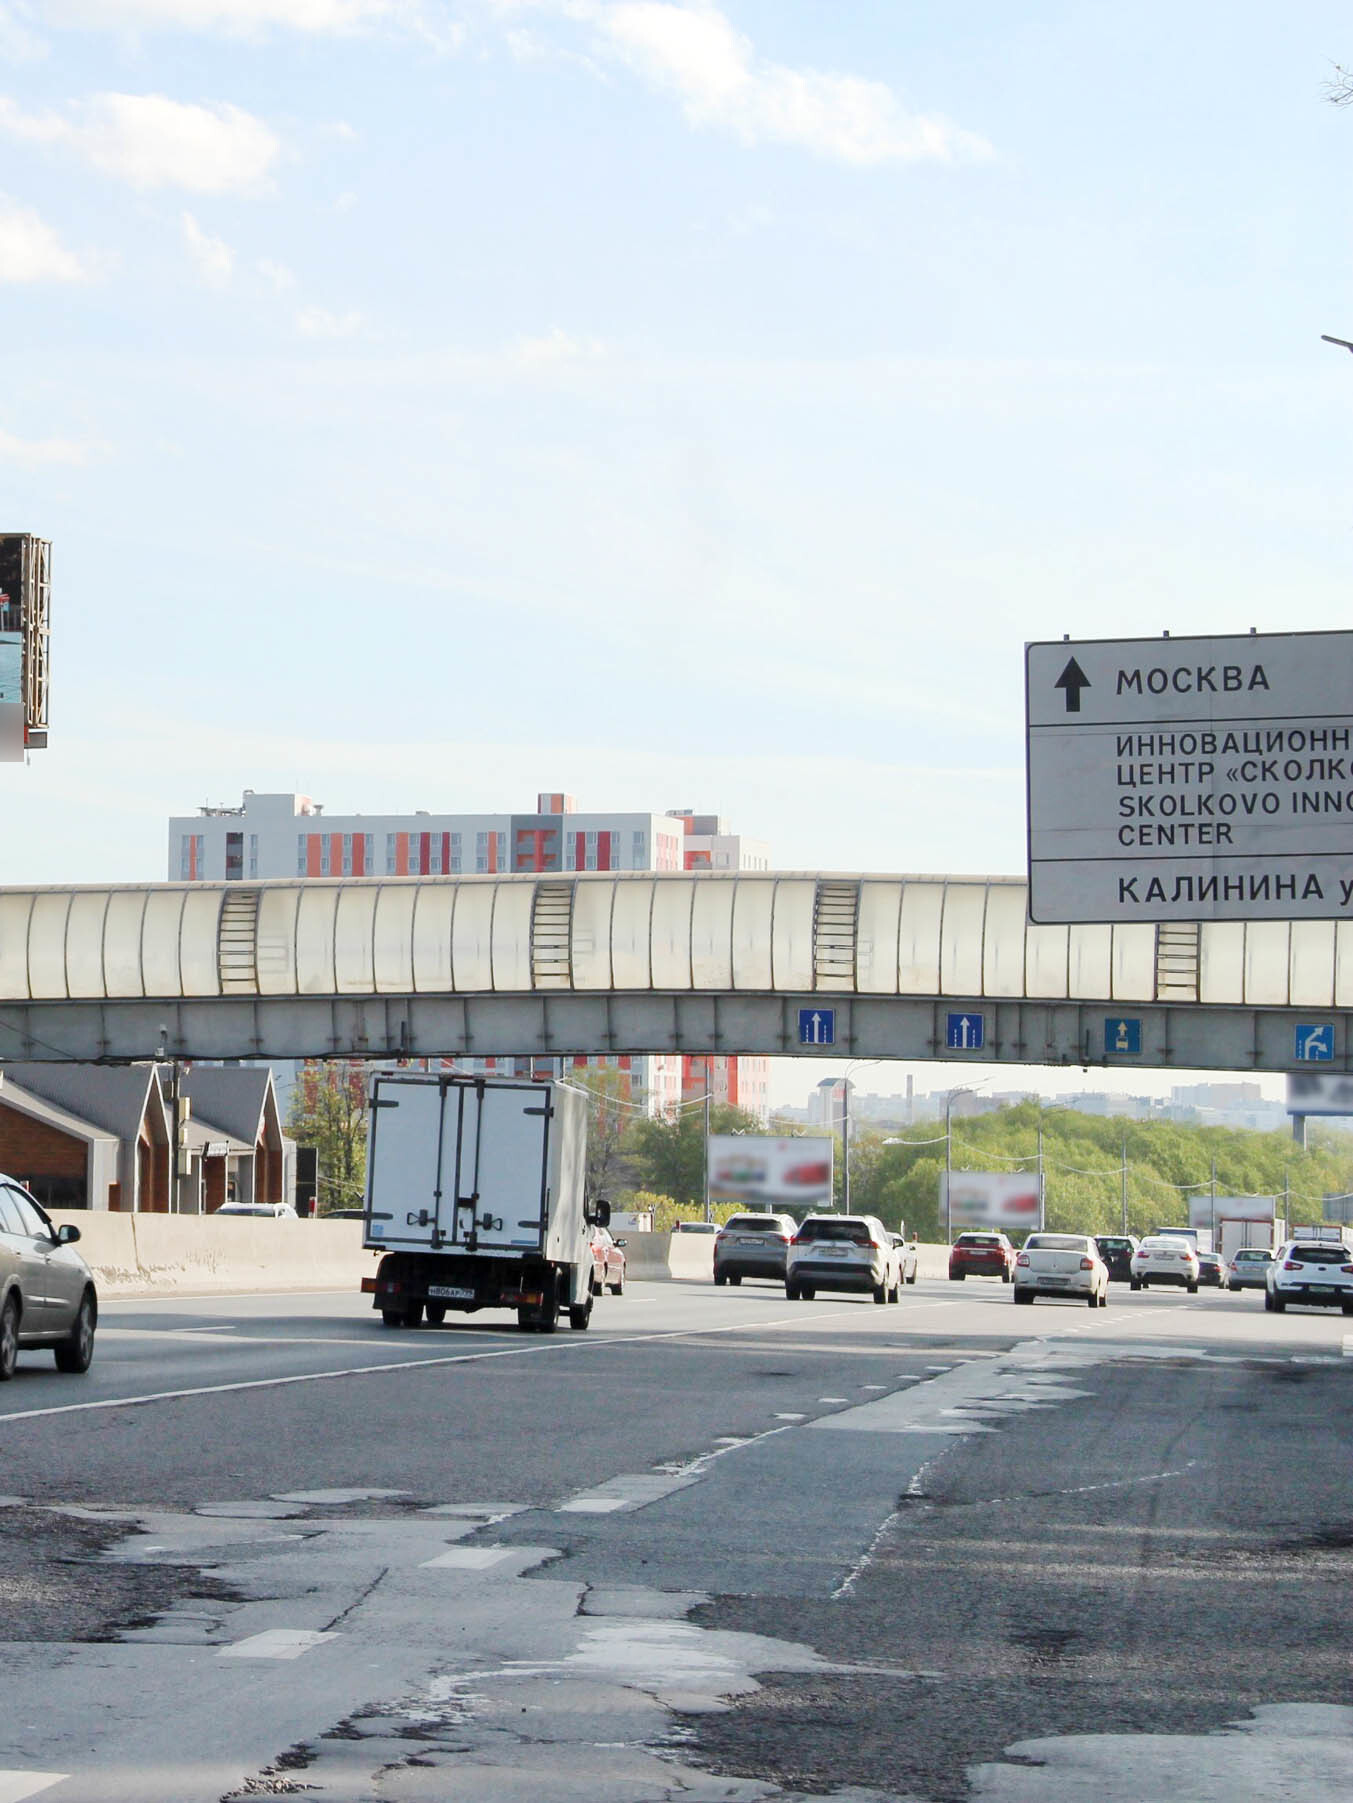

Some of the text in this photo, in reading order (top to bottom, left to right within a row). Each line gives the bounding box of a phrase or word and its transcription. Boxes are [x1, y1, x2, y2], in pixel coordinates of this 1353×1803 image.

[1115, 665, 1271, 695] МОСКВА
[1116, 729, 1350, 757] ИННОВАЦИОНН
[1116, 758, 1353, 788] ЦЕНТР «СКОЛК
[1118, 792, 1280, 817] SKOLKOVO
[1118, 823, 1234, 847] CENTER
[1119, 873, 1324, 903] КАЛИНИНА
